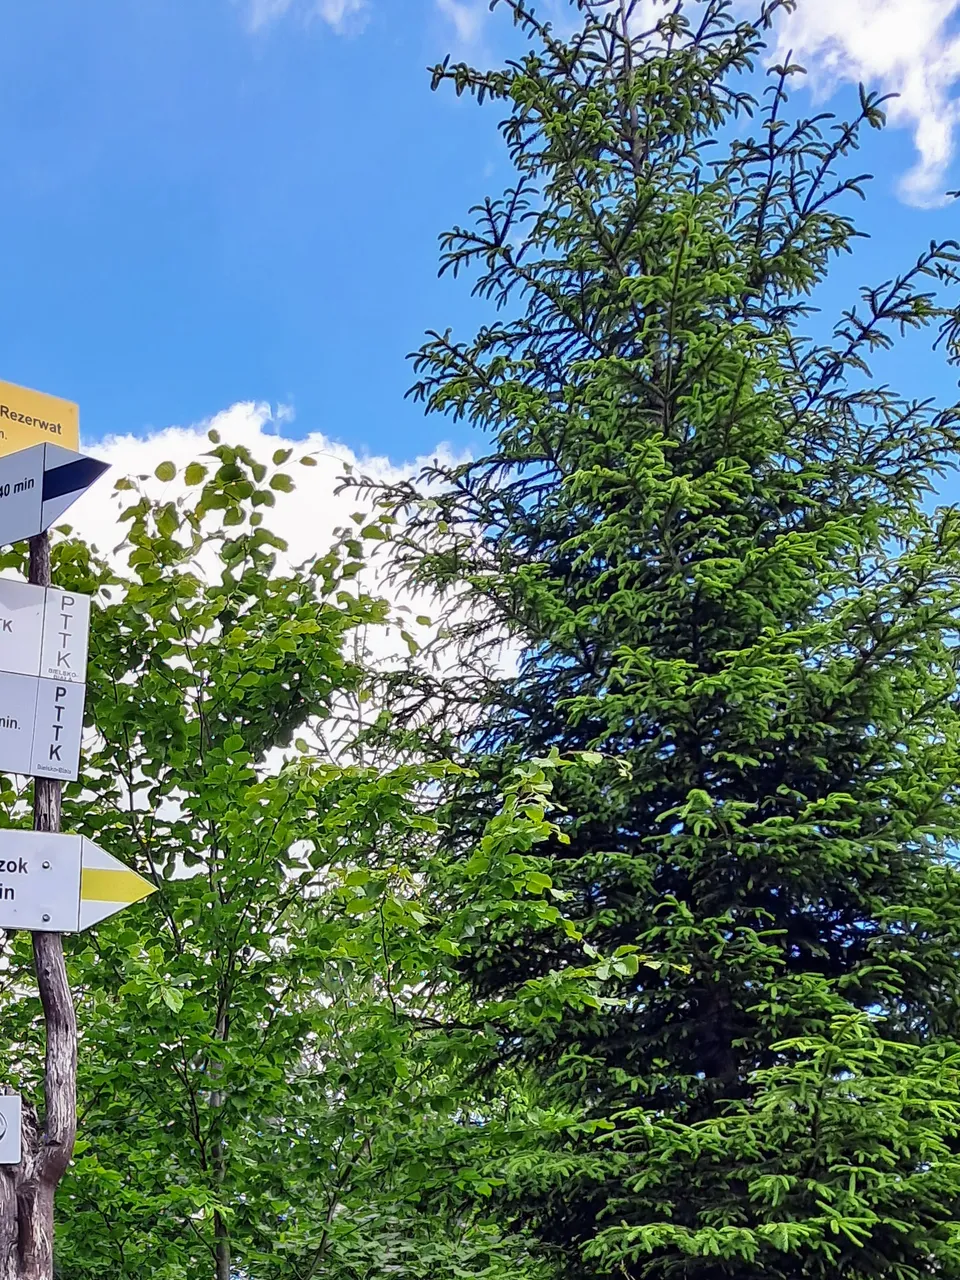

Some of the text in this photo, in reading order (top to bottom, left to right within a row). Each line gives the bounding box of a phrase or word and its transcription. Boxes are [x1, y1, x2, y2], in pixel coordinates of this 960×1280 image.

[0, 404, 62, 436] Rezerwat
[13, 476, 35, 494] min
[56, 595, 75, 669] PTTK
[49, 686, 67, 762] PTTK
